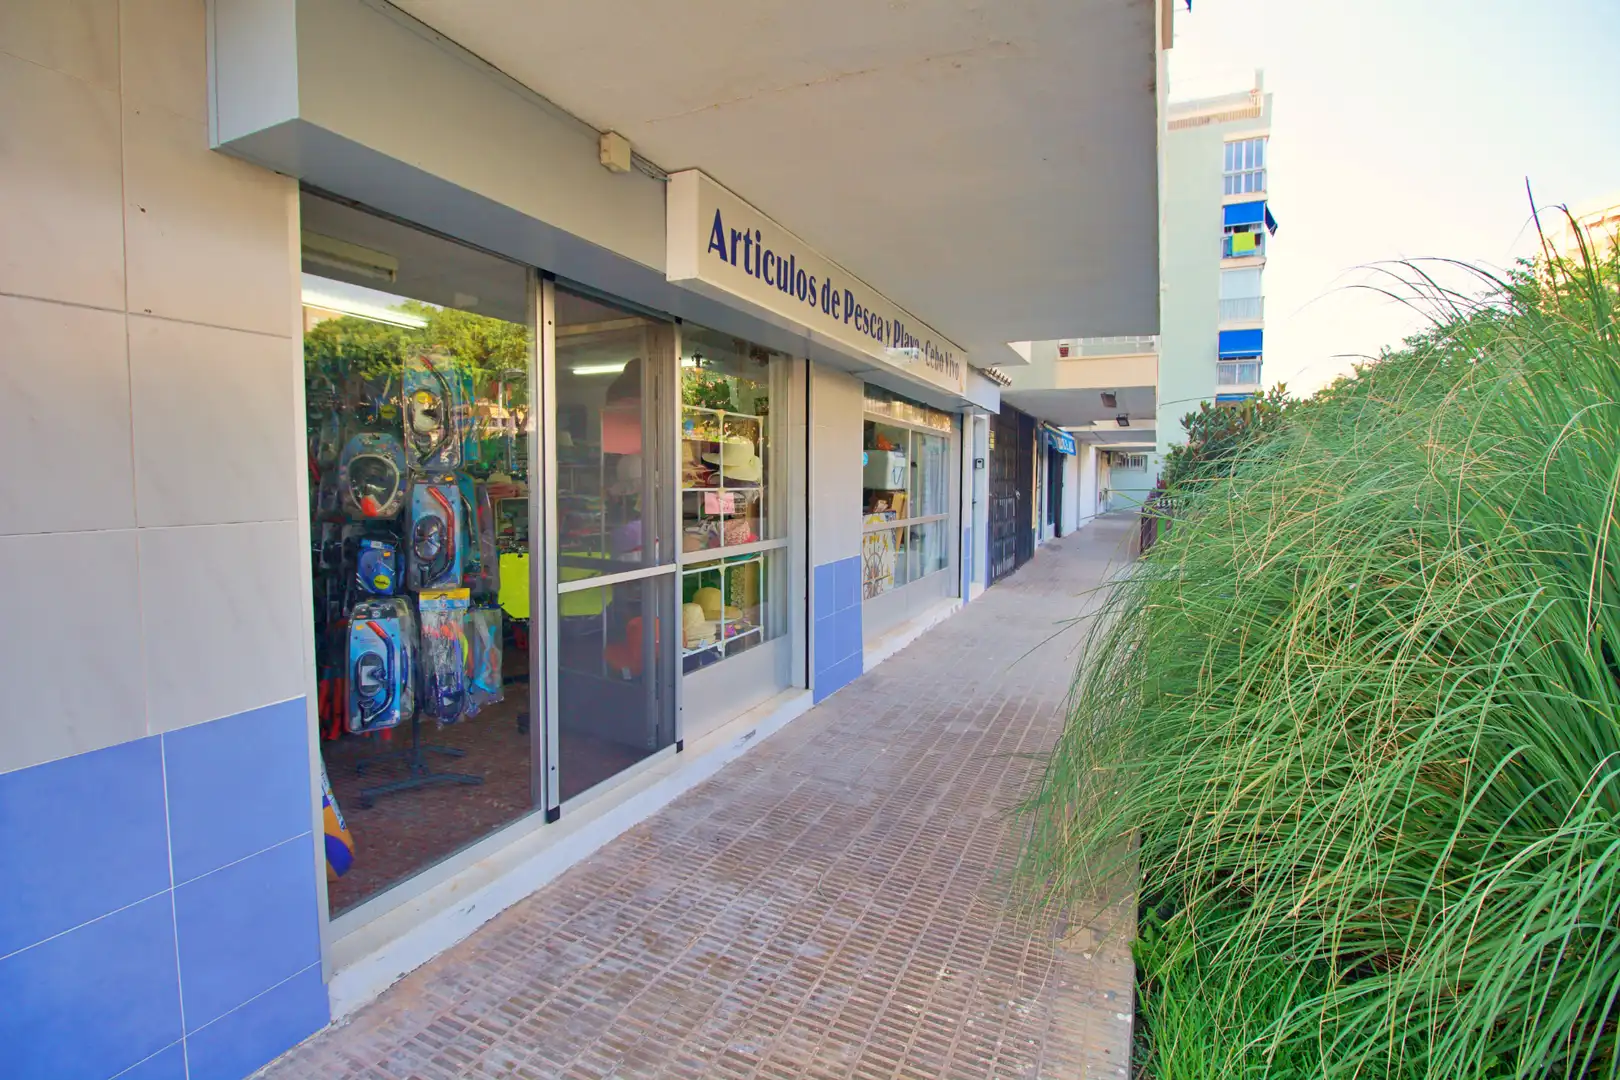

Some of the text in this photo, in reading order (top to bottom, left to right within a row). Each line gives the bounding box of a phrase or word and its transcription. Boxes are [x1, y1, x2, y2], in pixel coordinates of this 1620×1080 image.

[707, 208, 817, 307] Articulos
[820, 277, 840, 320] de
[843, 287, 884, 343] Pesca
[925, 340, 944, 373] Cebo
[945, 351, 960, 381] Vivo
